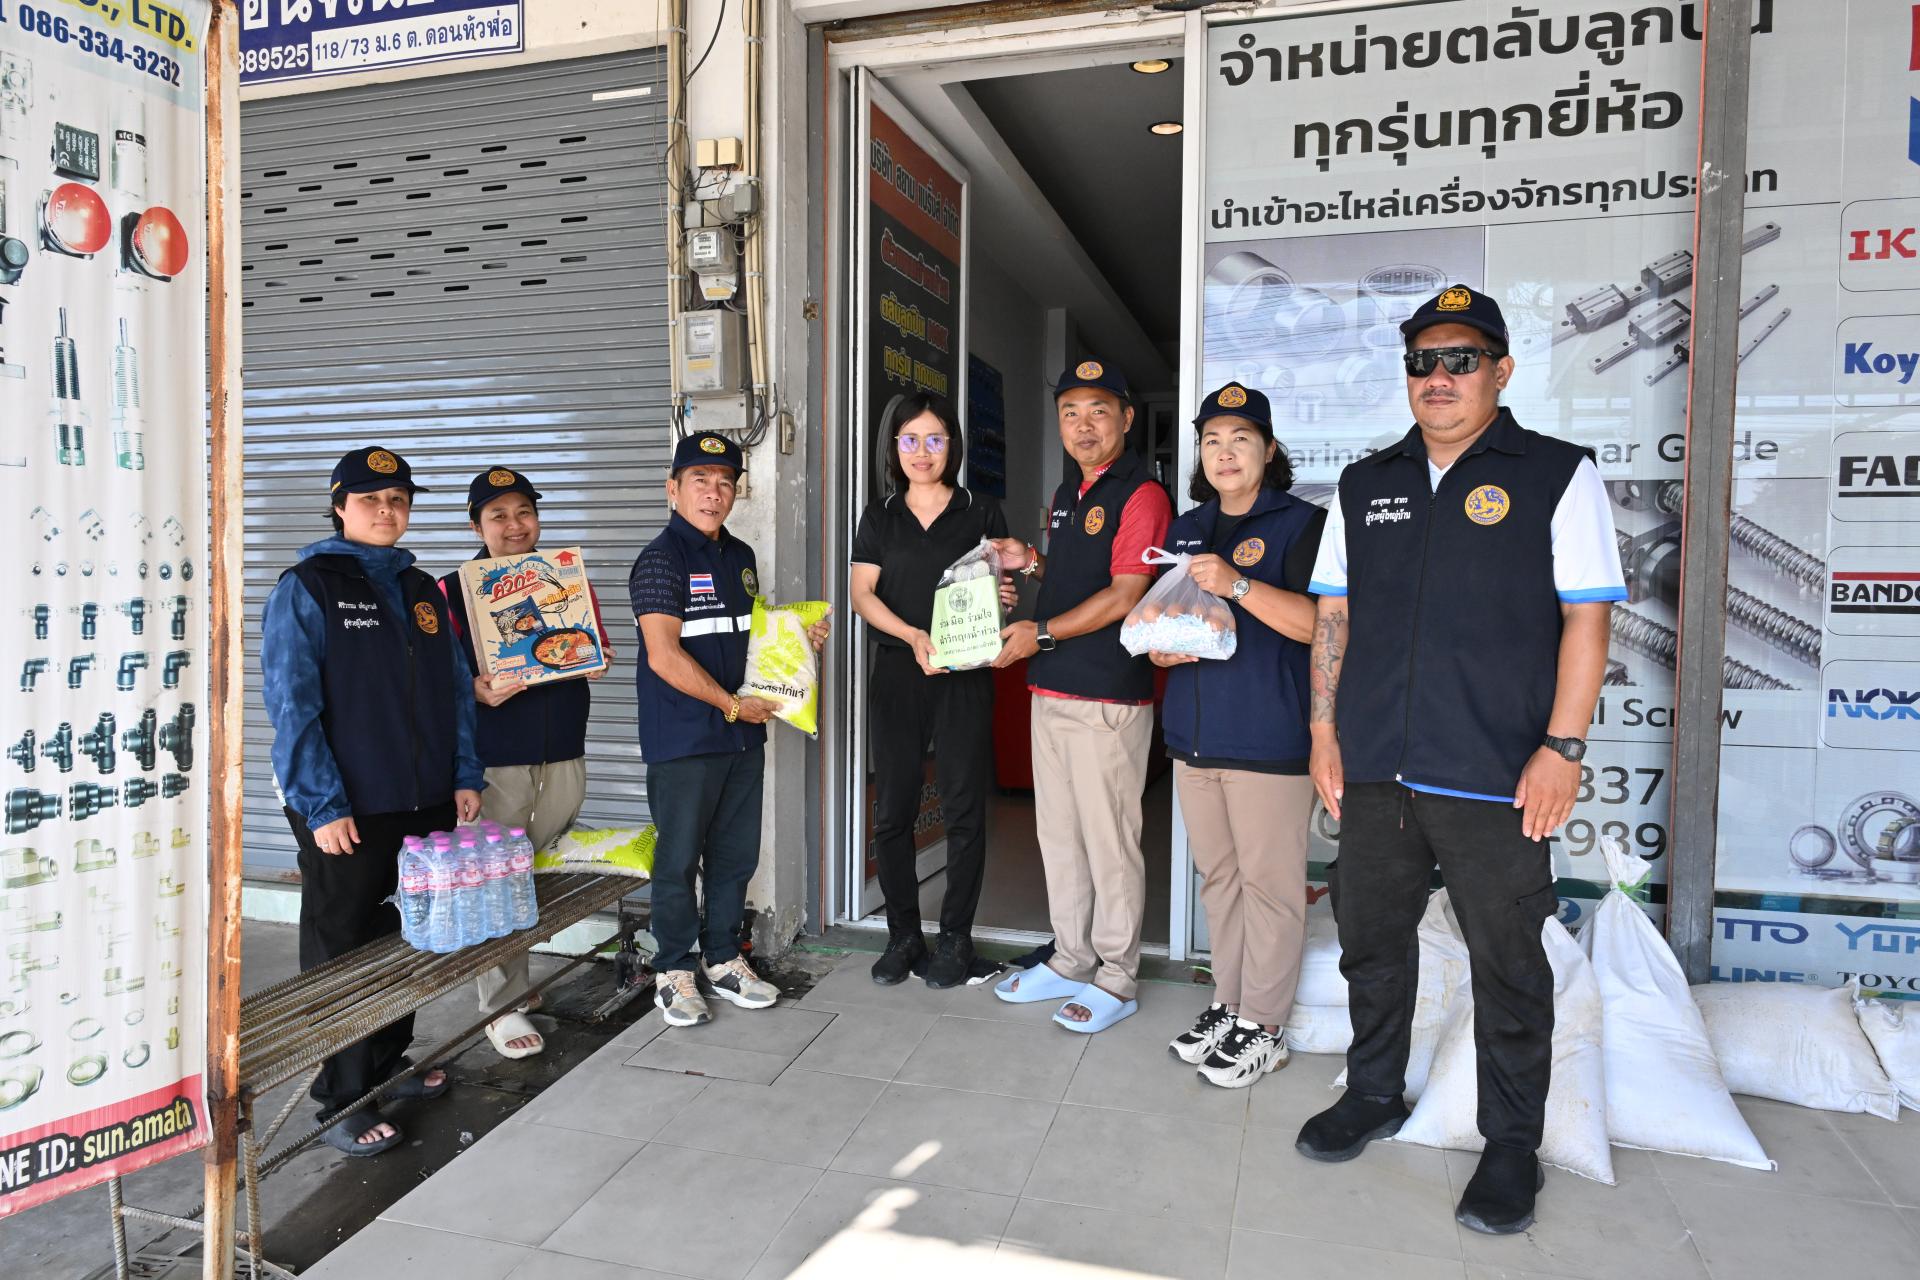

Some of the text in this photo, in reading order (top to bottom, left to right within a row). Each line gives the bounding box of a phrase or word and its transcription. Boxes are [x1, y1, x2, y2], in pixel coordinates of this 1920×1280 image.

[19, 4, 181, 87] 086-334-3232
[315, 39, 370, 61] 118/73
[376, 32, 401, 52] ม.6
[407, 30, 422, 48] ต.
[426, 9, 512, 44] ดอนหัวฬ่อ
[1294, 70, 1683, 172] ทุกรุ่นทุกยี่ห้อ
[1844, 341, 1920, 385] Koy
[38, 1138, 76, 1178] ID:
[83, 1100, 192, 1163] sun.amata
